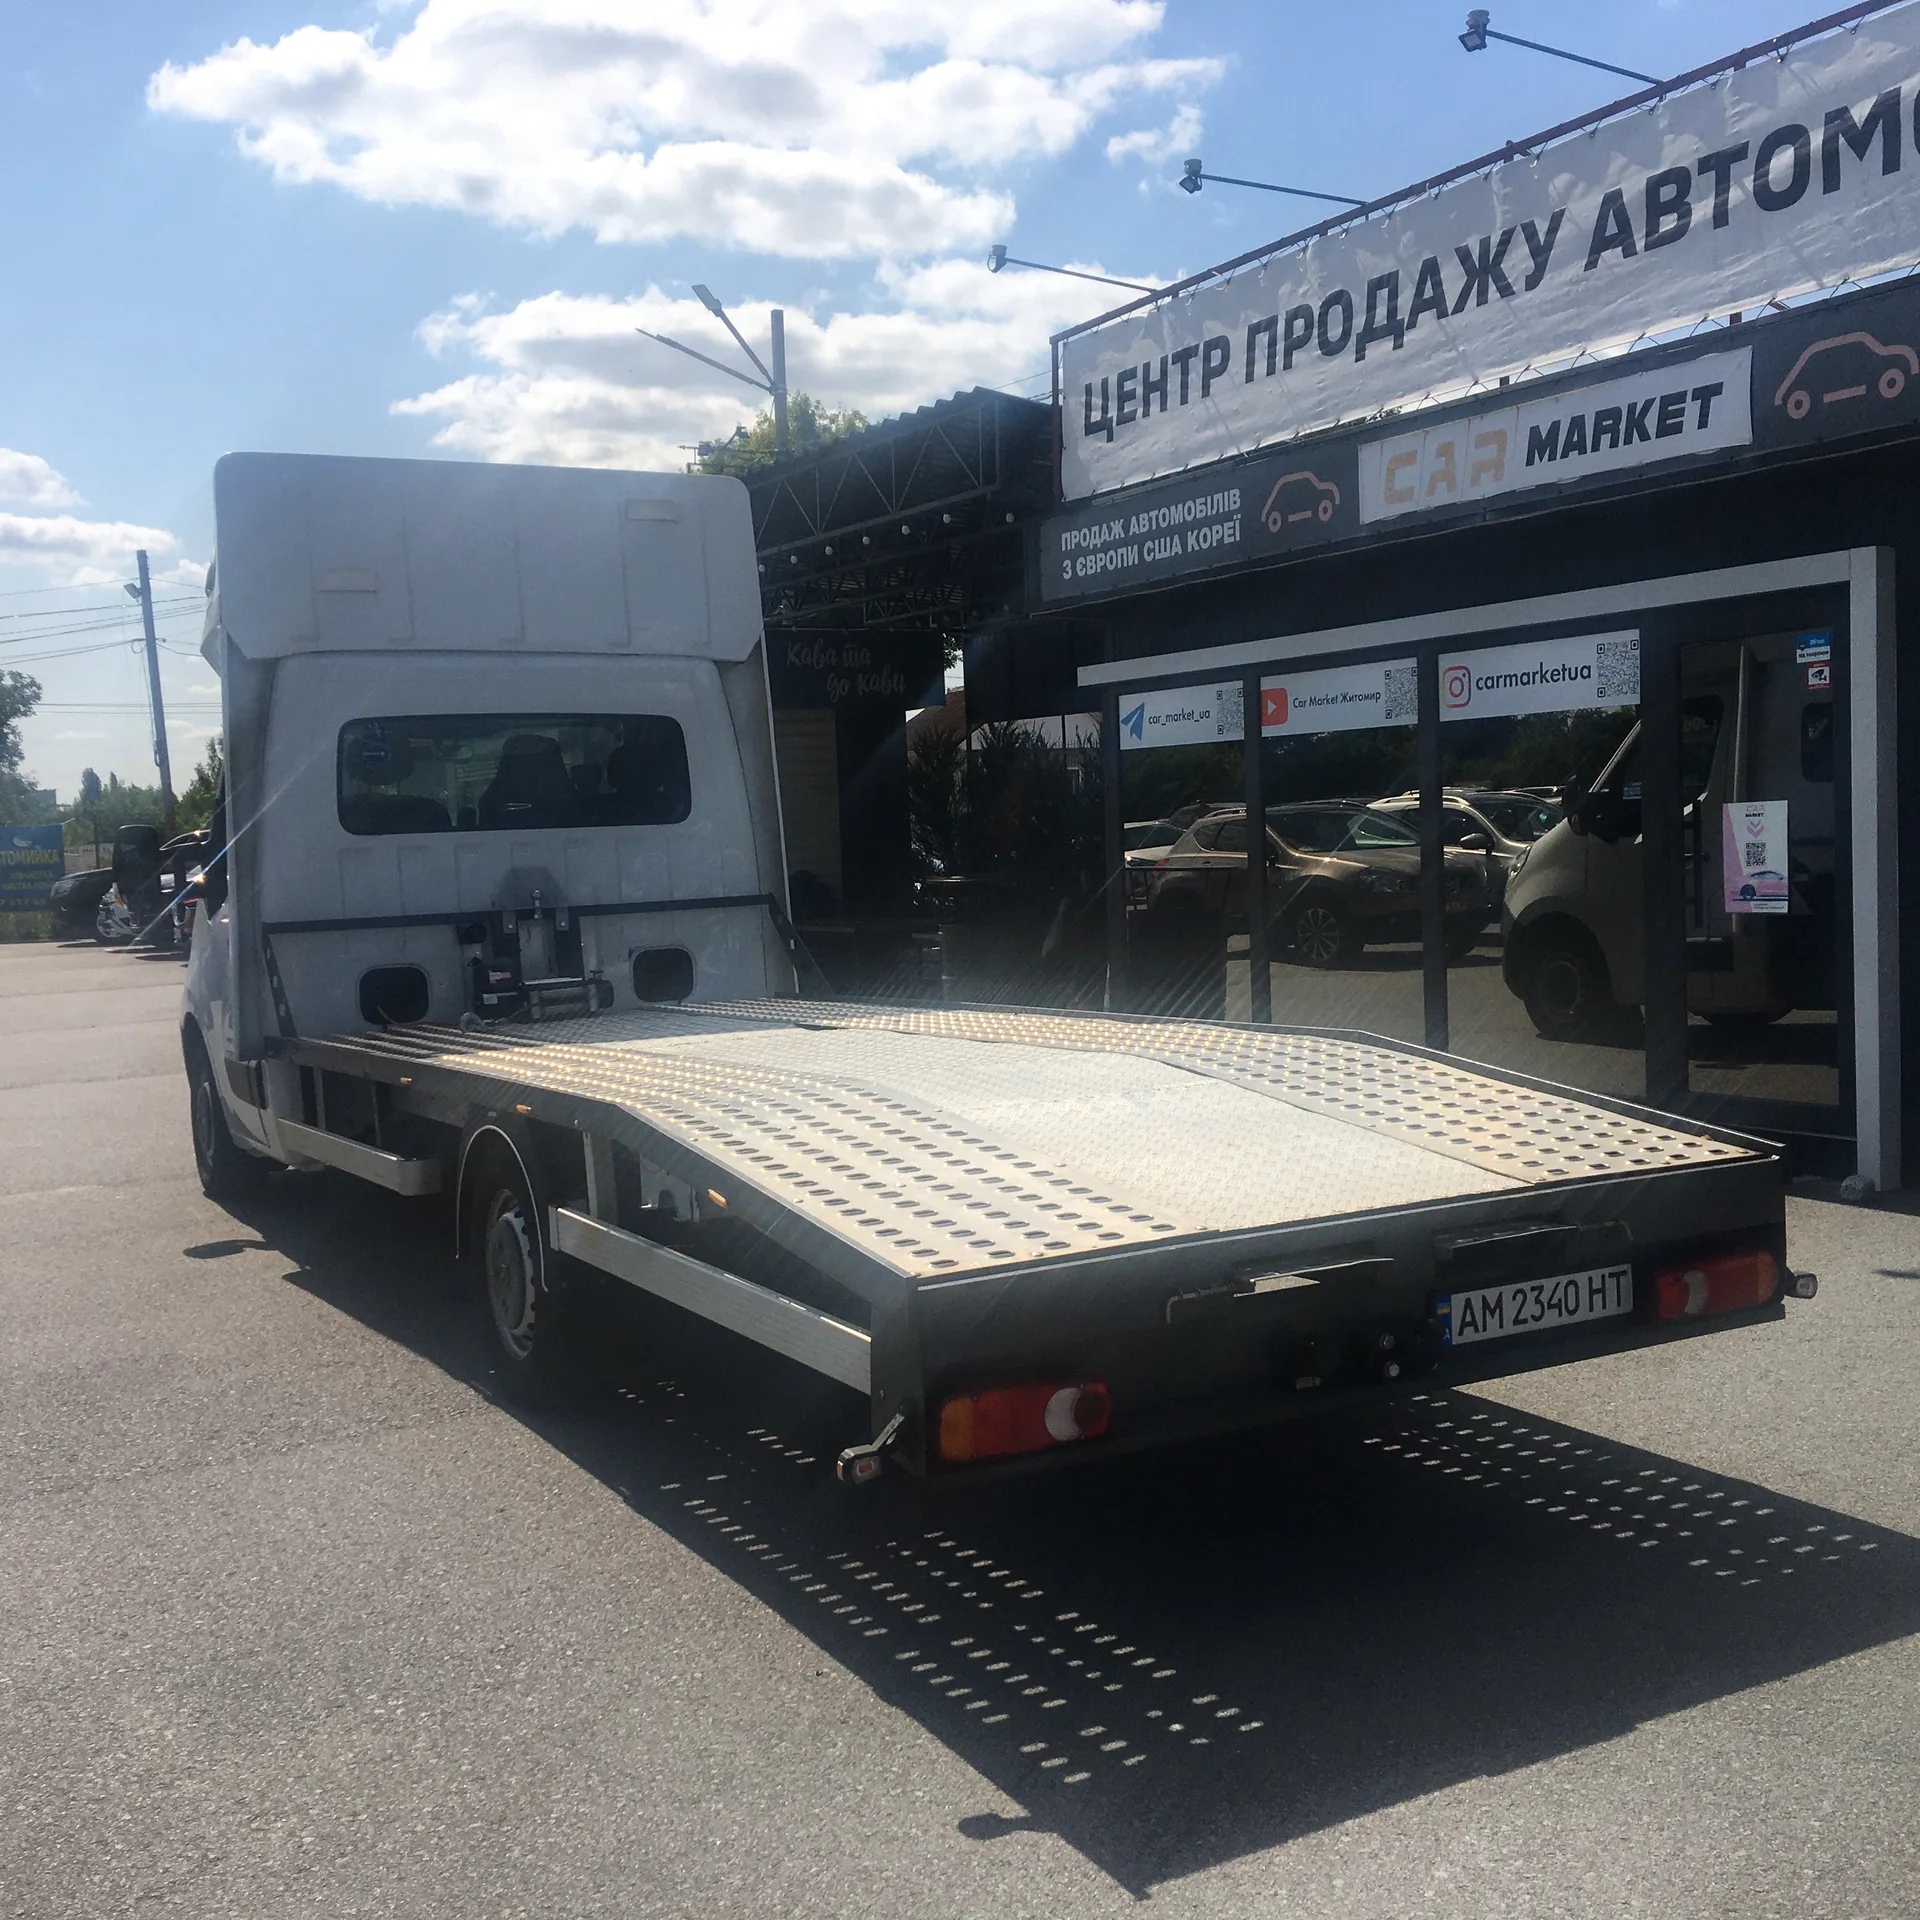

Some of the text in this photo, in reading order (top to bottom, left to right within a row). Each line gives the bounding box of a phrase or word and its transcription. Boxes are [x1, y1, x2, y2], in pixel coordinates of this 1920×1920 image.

[1084, 86, 1920, 442] ЦЕНТР ПРОДАЖУ АВТОМ
[1384, 382, 1724, 505] CAR MARKET
[1061, 488, 1241, 551] ПРОДАЖ АВТОМОБІЛІВ
[1062, 514, 1242, 580] З ЄВРОПИ США КОРЕЇ
[787, 638, 838, 669] Кава
[1475, 662, 1592, 691] carmarketua
[826, 665, 907, 703] до кави
[1292, 690, 1381, 709] Car Market Житомир
[1148, 708, 1211, 726] car_market_ua
[1458, 1269, 1628, 1336] AM 2340 HT
